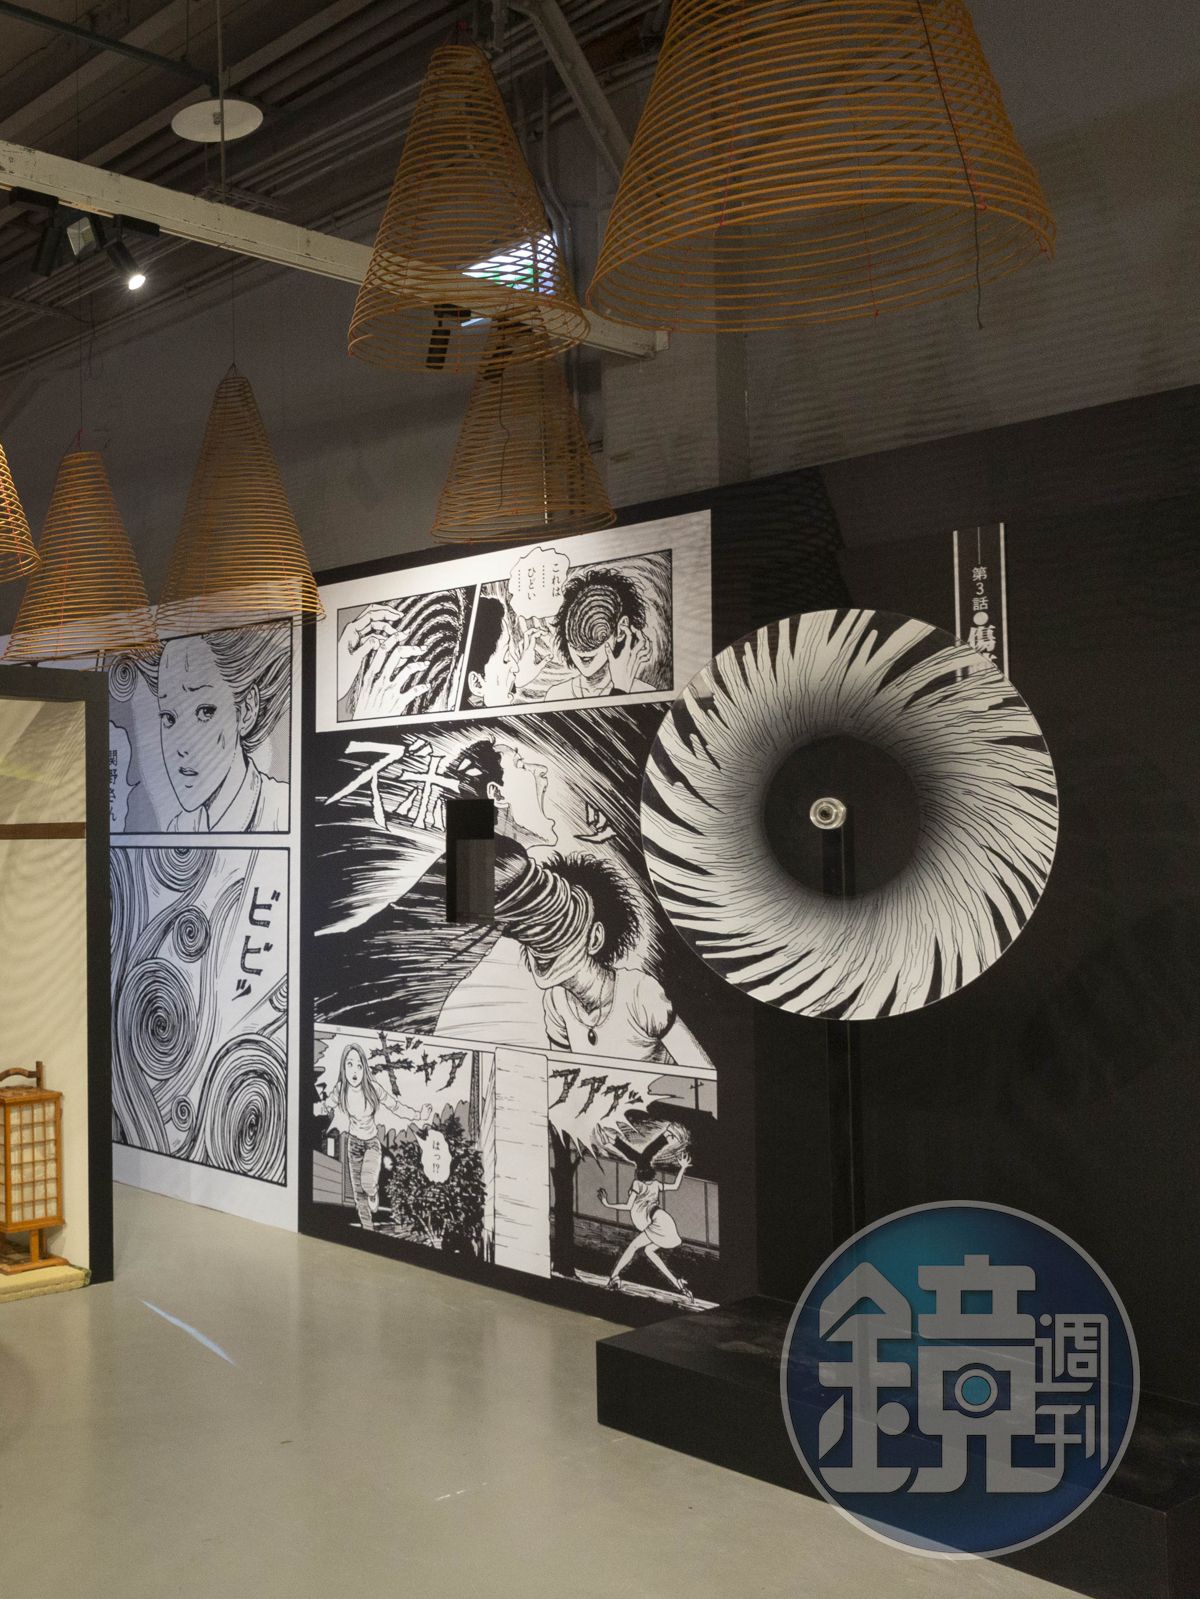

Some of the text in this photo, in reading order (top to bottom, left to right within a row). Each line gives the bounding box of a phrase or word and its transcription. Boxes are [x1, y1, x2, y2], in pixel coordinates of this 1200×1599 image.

[527, 567, 537, 601] ひどい
[551, 563, 561, 598] これは
[368, 1030, 468, 1098] ギャア
